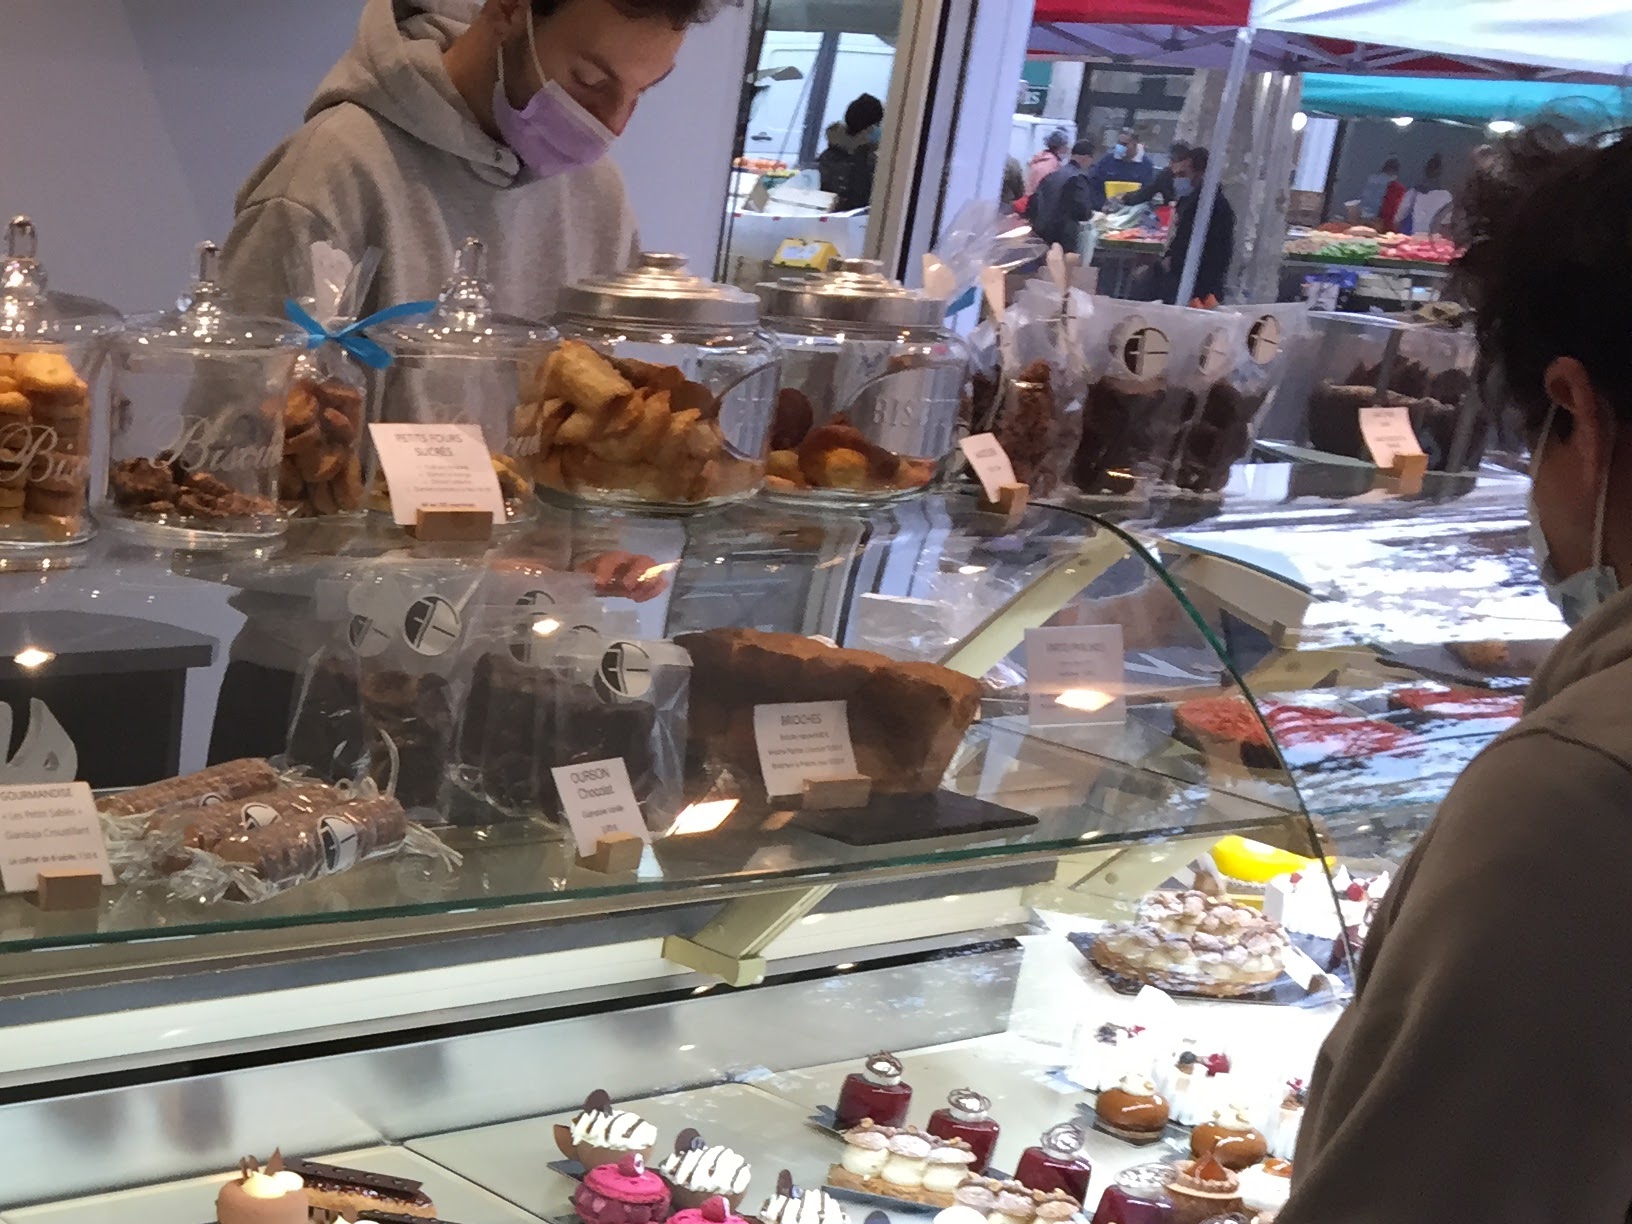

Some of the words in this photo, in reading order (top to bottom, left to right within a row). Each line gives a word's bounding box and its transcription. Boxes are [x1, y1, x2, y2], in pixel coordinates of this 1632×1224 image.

[393, 433, 430, 444] PETITS
[430, 432, 464, 444] FOURS
[569, 766, 610, 784] OURSON
[0, 788, 73, 801] GOURMANDISE
[577, 783, 614, 799] Chocolat
